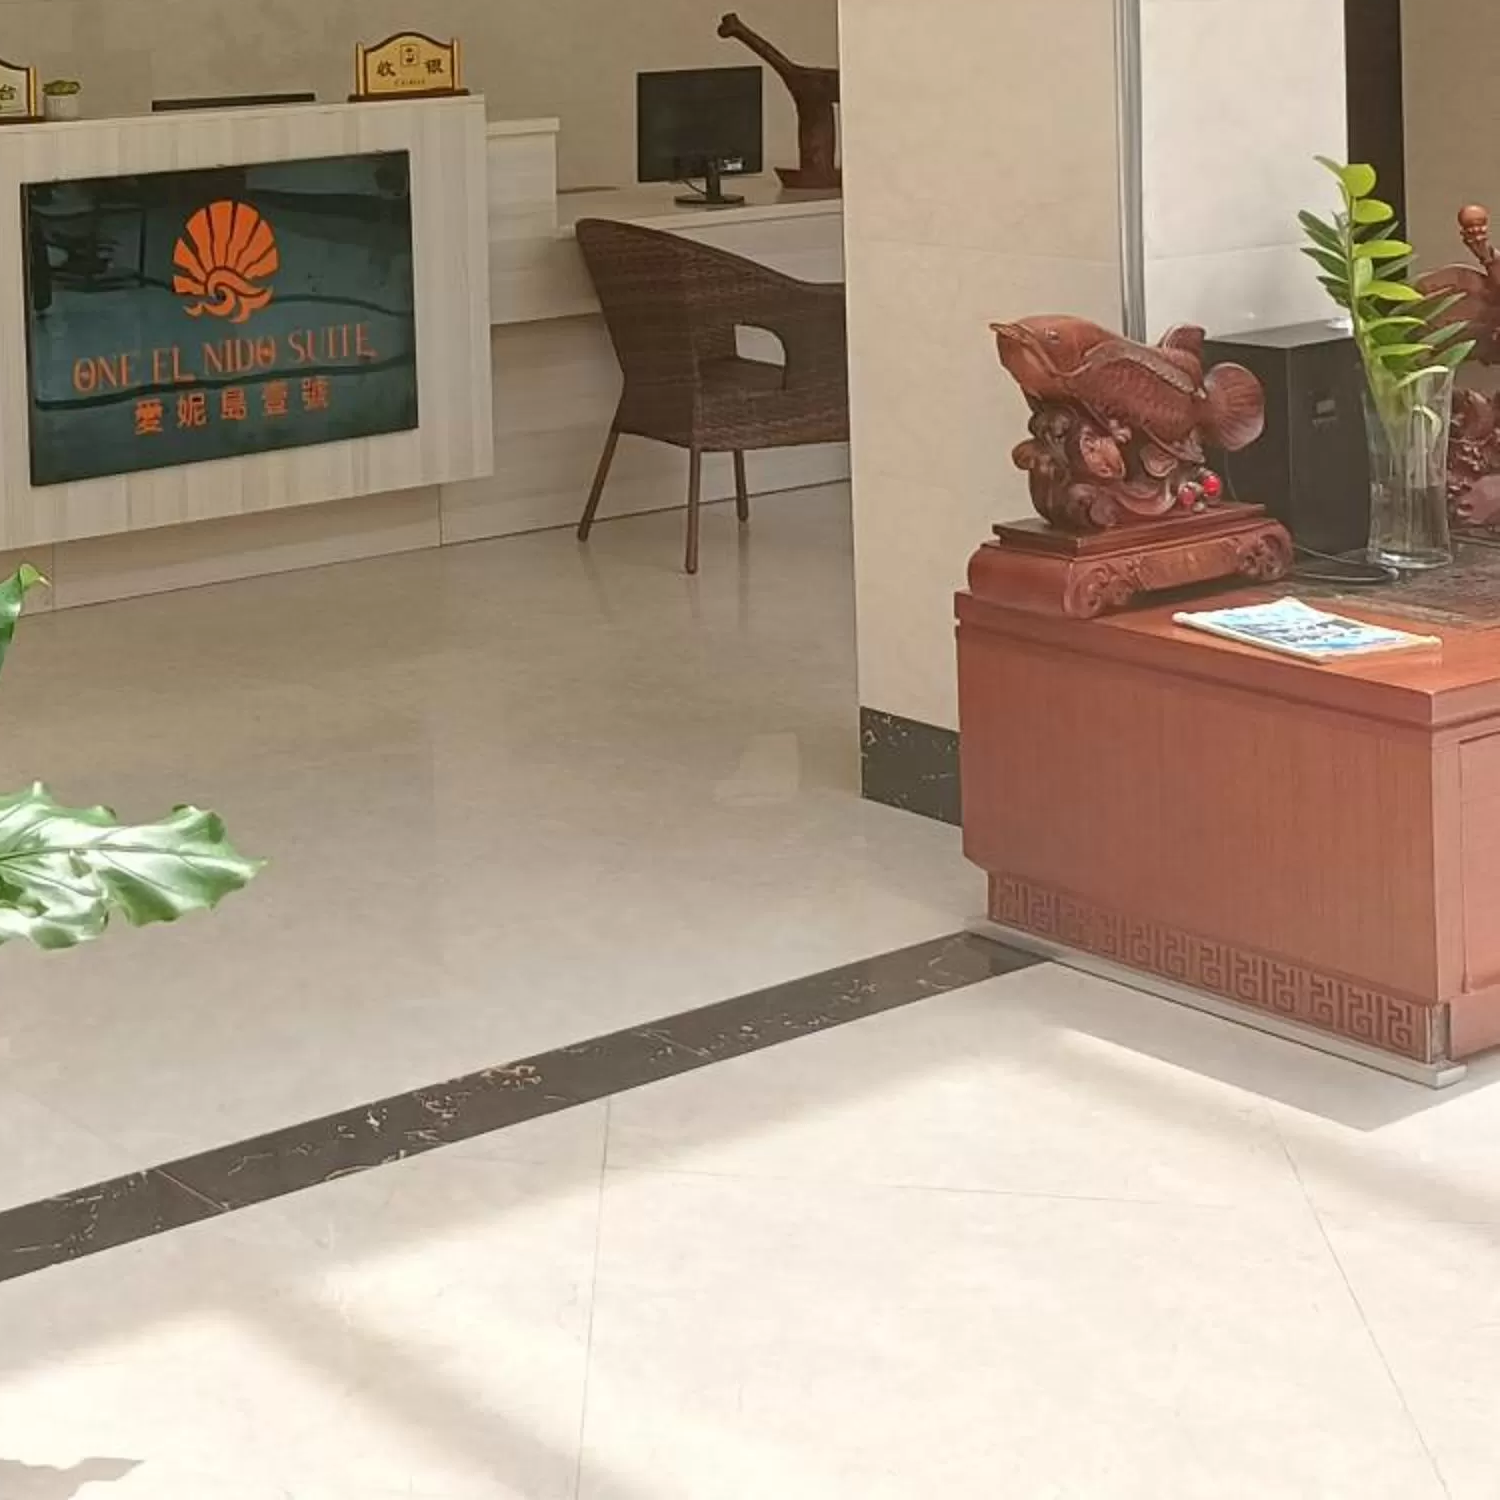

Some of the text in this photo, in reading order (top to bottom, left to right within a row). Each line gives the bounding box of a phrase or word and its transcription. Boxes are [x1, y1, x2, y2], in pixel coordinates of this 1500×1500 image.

[72, 323, 378, 393] ONE EL NIDO SUITE
[134, 377, 330, 435] 愛妮島壹號
